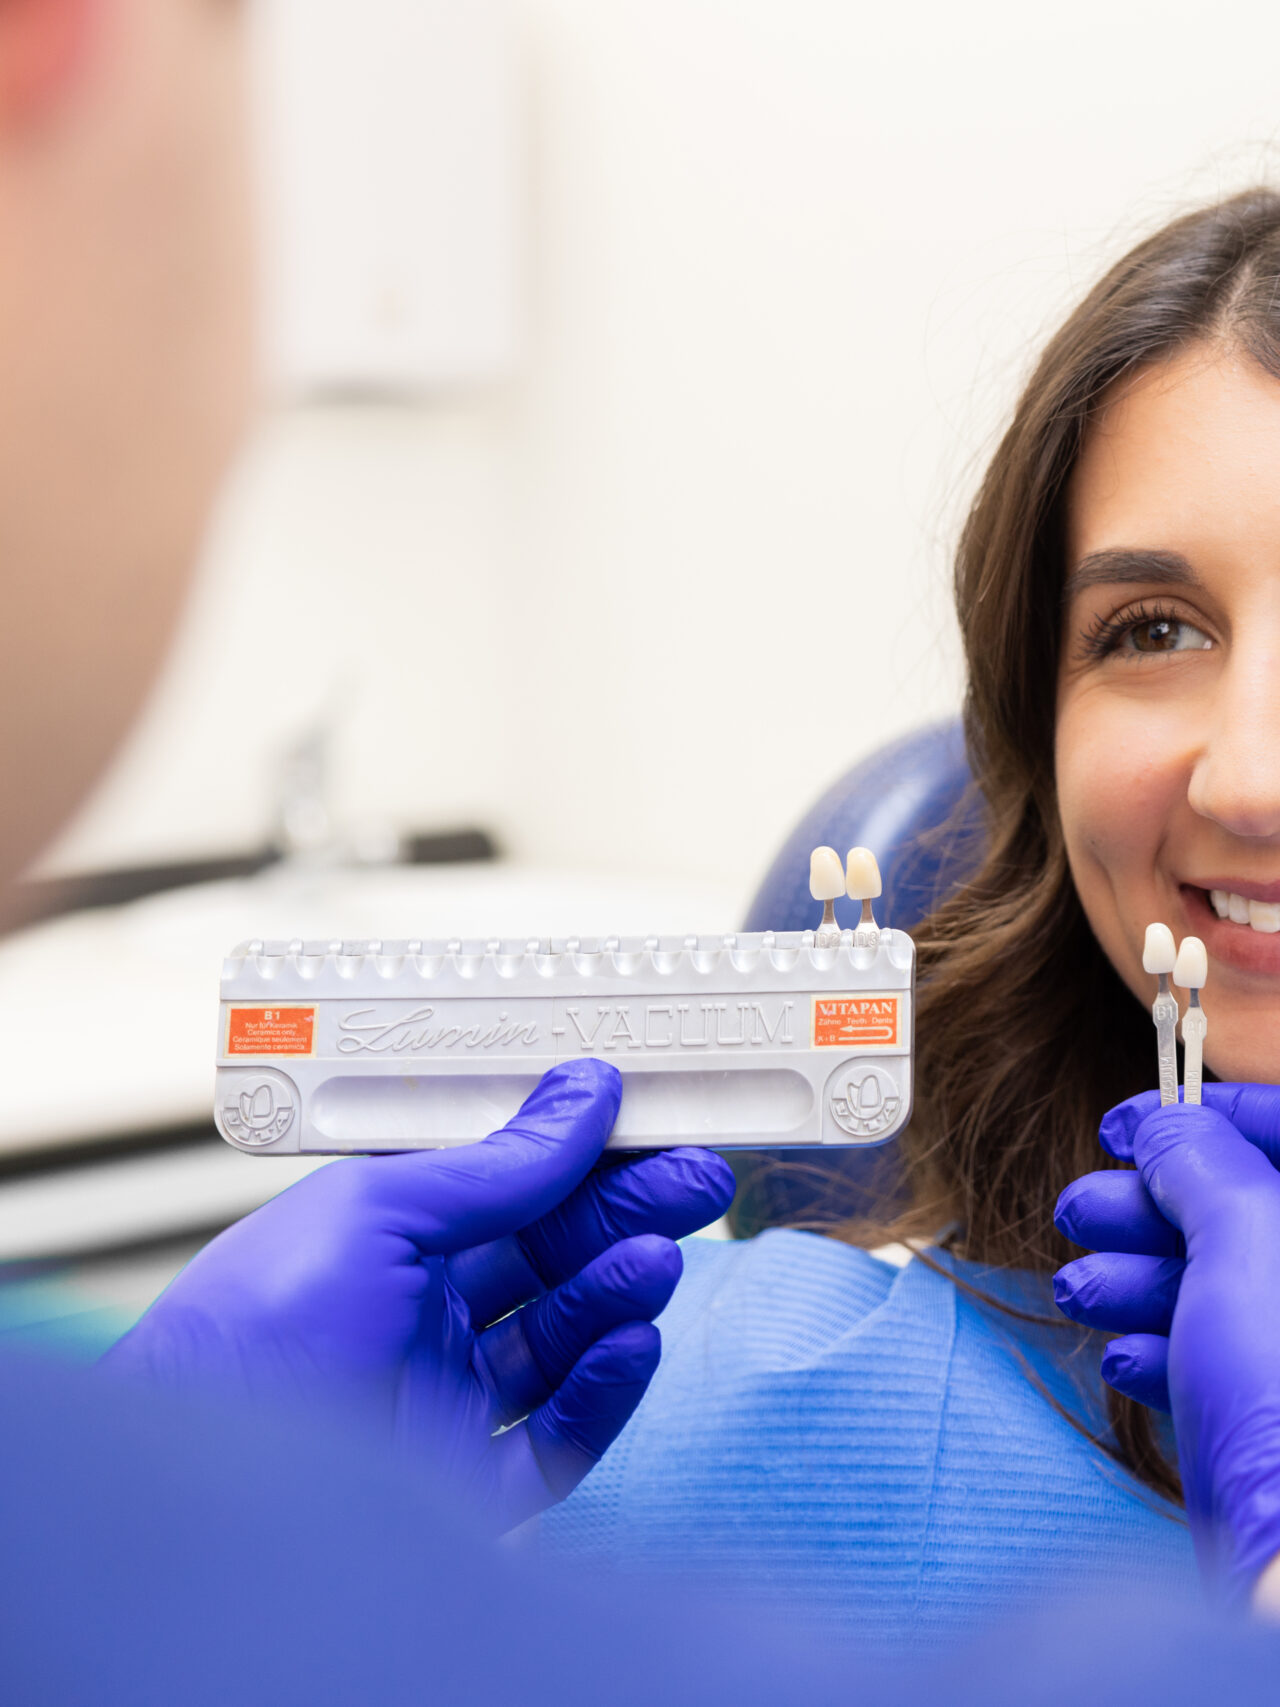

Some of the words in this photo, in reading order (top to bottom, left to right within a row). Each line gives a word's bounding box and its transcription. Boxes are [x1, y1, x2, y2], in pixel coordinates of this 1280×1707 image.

[819, 1001, 893, 1016] VITAPAN
[1156, 1004, 1174, 1021] B1
[336, 1005, 540, 1054] Lumin
